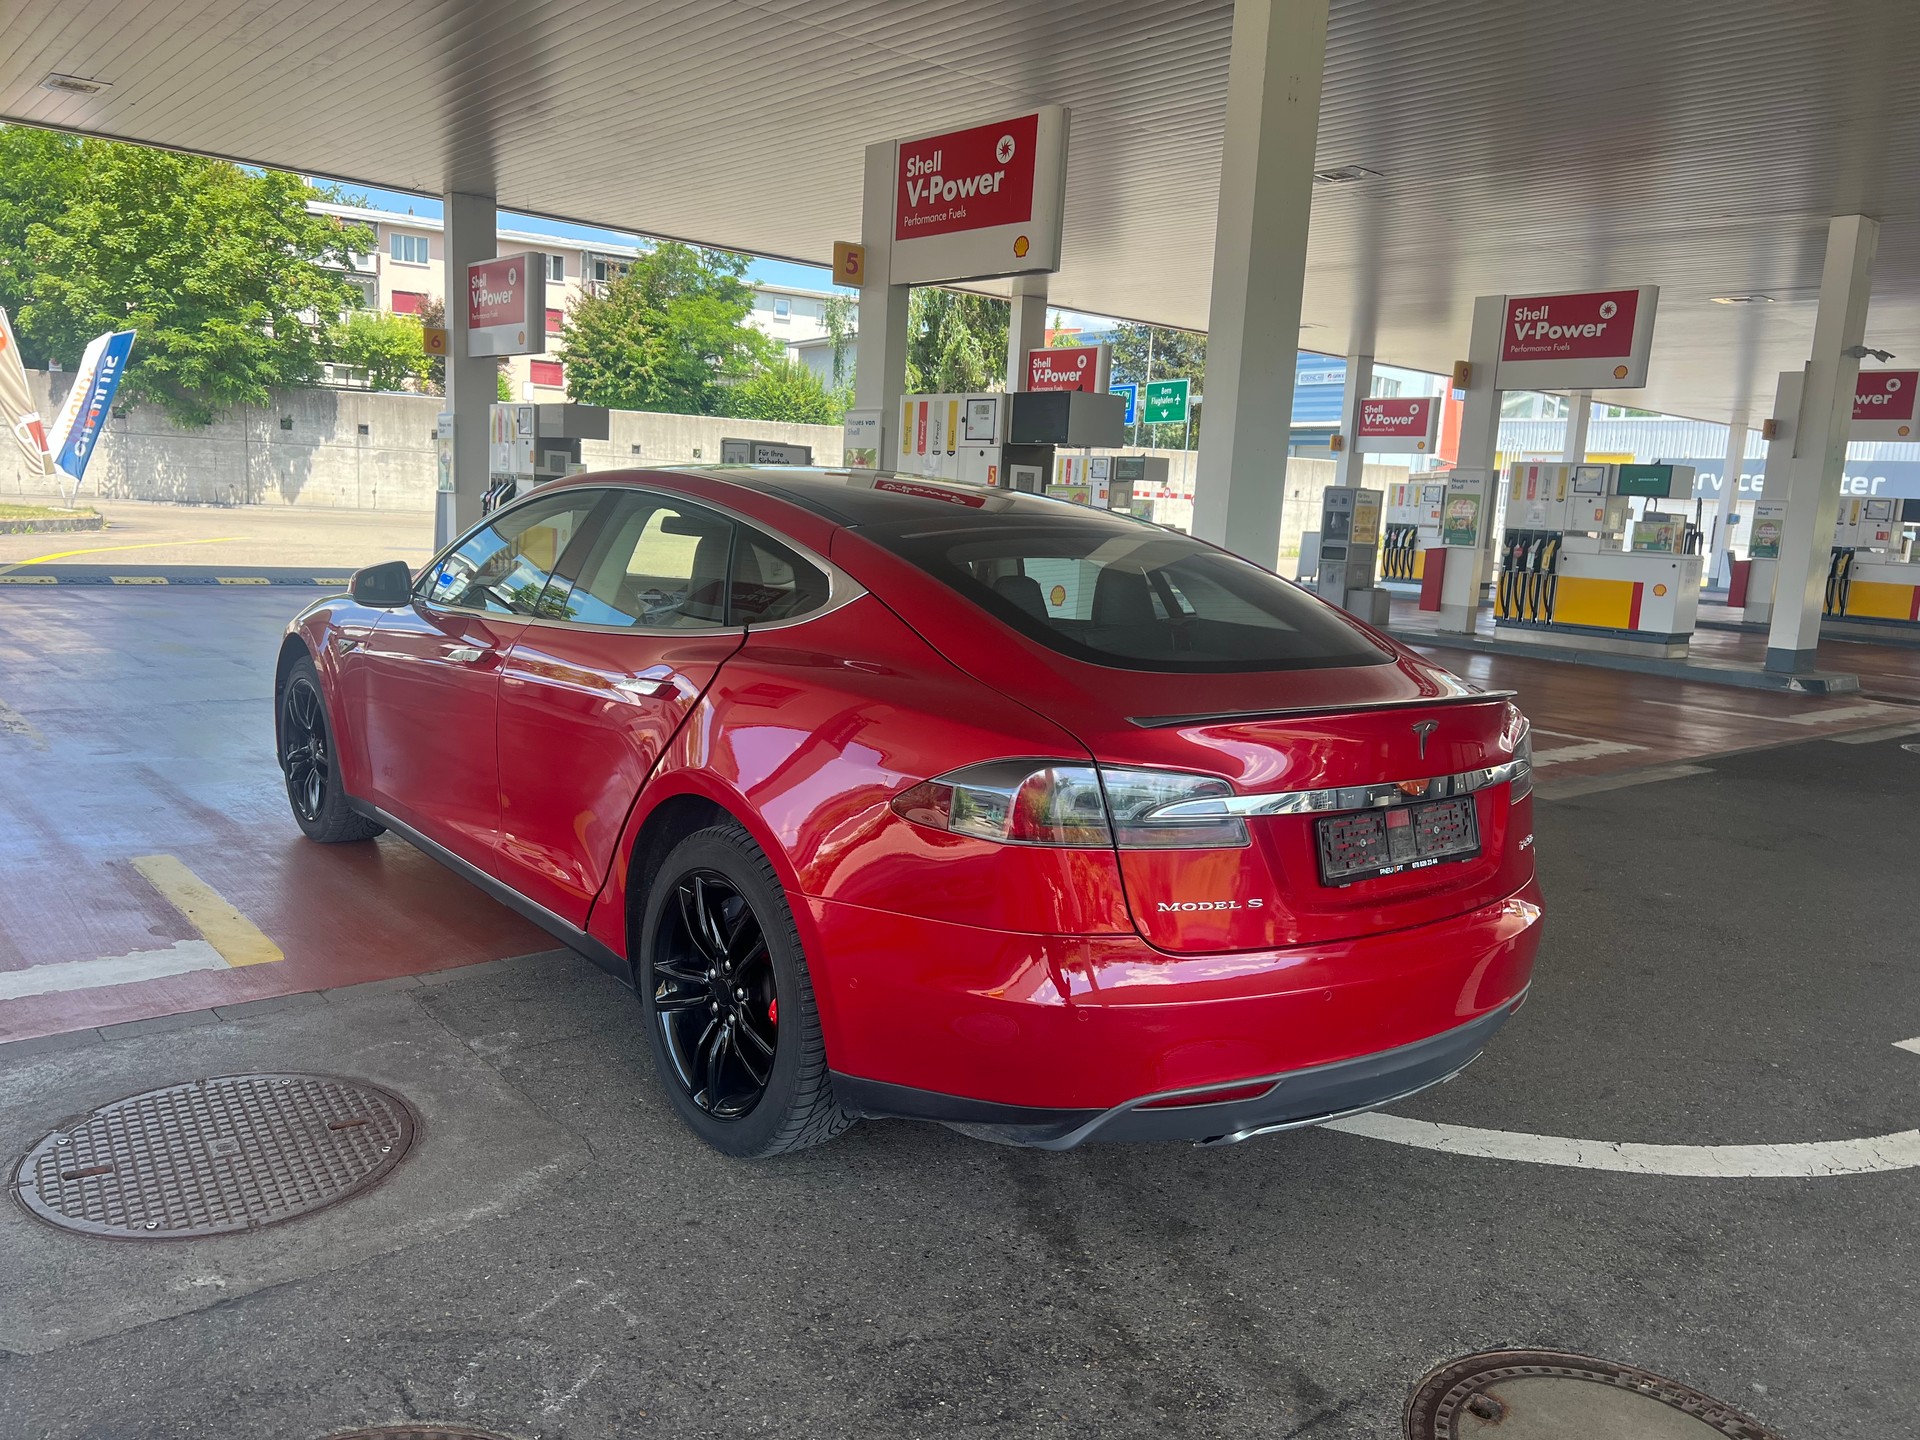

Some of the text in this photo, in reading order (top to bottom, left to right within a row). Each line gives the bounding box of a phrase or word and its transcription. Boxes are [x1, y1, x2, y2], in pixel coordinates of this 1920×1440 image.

[906, 150, 942, 177] Shell
[906, 170, 1005, 208] V-Power
[904, 205, 967, 227] Performance Fuels
[846, 252, 859, 275] 5
[472, 273, 487, 289] Shell
[472, 290, 513, 308] V-Power
[1515, 305, 1549, 321] Shell
[1514, 321, 1607, 341] V-Power
[431, 335, 441, 348] 6
[1510, 342, 1570, 353] Performance Fuels
[1033, 357, 1051, 368] Shell
[1032, 369, 1082, 383] V-Power
[1462, 367, 1469, 382] 9
[1161, 387, 1172, 395] Bern
[1151, 396, 1174, 406] Flughafen
[1364, 405, 1383, 413] Shell
[1364, 414, 1414, 425] V-Power
[847, 428, 860, 436] Shell
[770, 450, 784, 458] Ihre
[989, 467, 995, 483] 5
[1157, 898, 1264, 912] MODEL S
